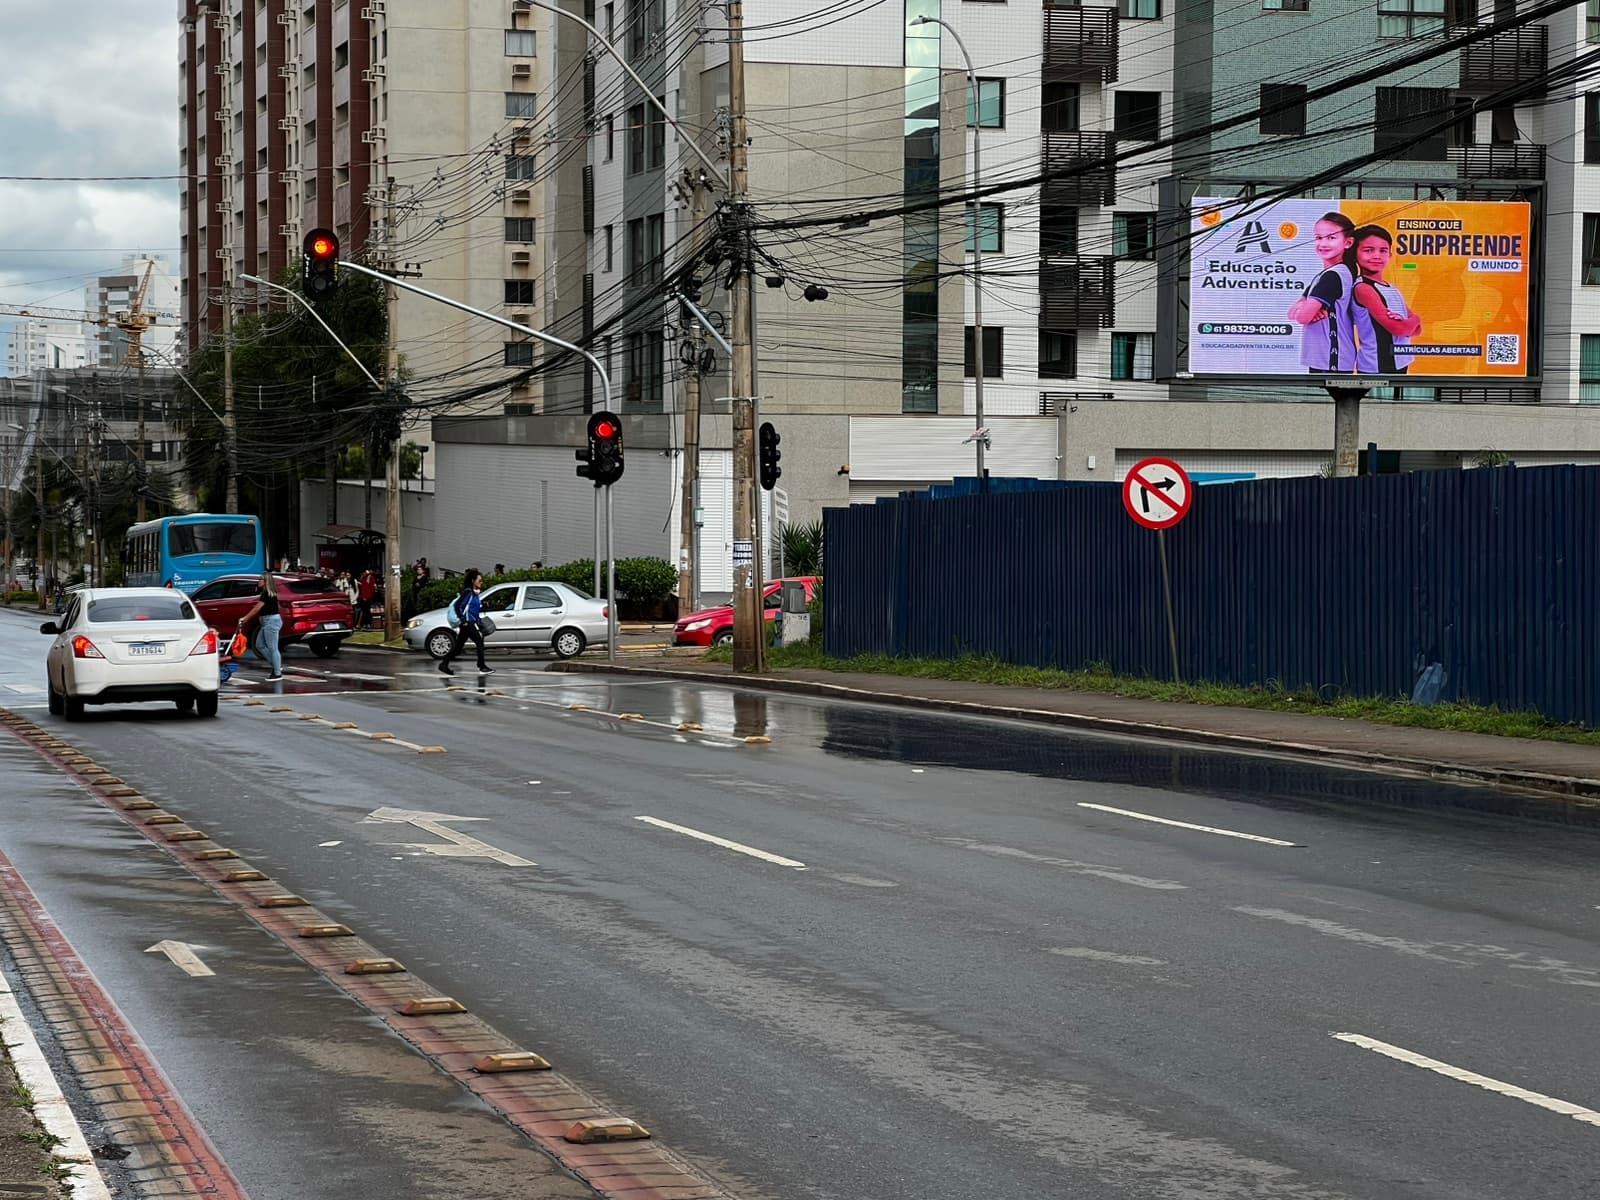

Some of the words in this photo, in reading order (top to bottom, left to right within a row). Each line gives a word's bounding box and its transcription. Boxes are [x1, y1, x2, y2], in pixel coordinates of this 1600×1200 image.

[1399, 220, 1436, 229] ENSINO
[1438, 220, 1461, 229] QUE
[1396, 234, 1522, 256] SURPREENDE
[1208, 260, 1297, 275] Educação
[1470, 260, 1479, 269] O
[1481, 260, 1519, 270] MUNDO
[1201, 276, 1305, 289] Adventista
[1223, 325, 1287, 334] 98329-0006
[1393, 345, 1440, 354] MATRÍCULAS
